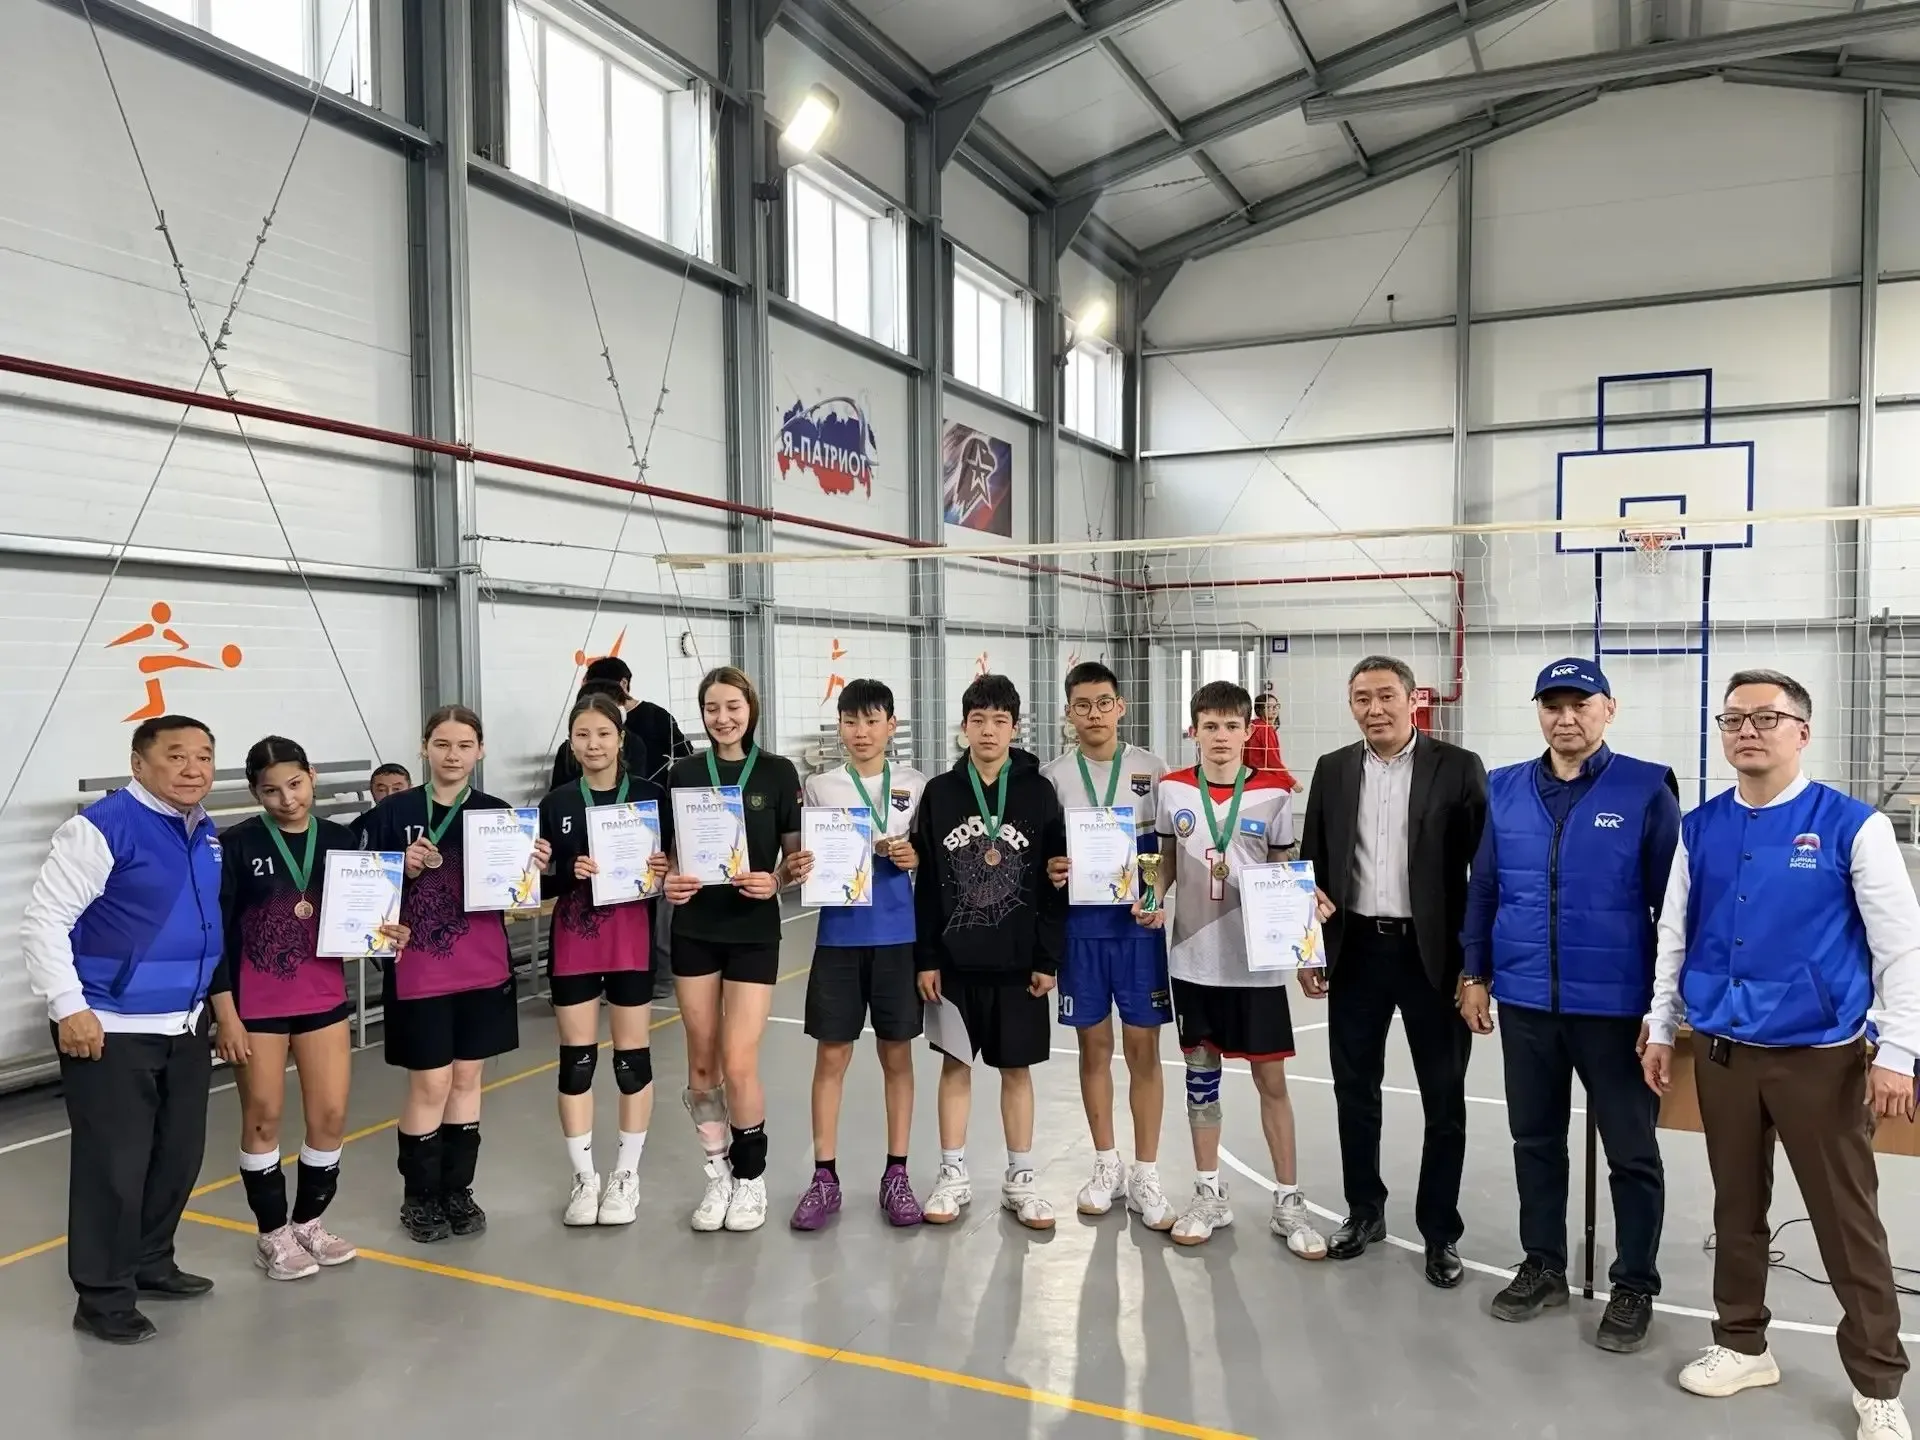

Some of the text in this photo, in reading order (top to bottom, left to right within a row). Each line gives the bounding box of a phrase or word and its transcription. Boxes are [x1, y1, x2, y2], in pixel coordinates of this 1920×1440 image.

[783, 431, 867, 478] Я-ПАТРИОТ
[404, 825, 424, 845] 17
[562, 816, 572, 834] 5
[251, 856, 275, 876] 21
[1205, 847, 1225, 901] 1
